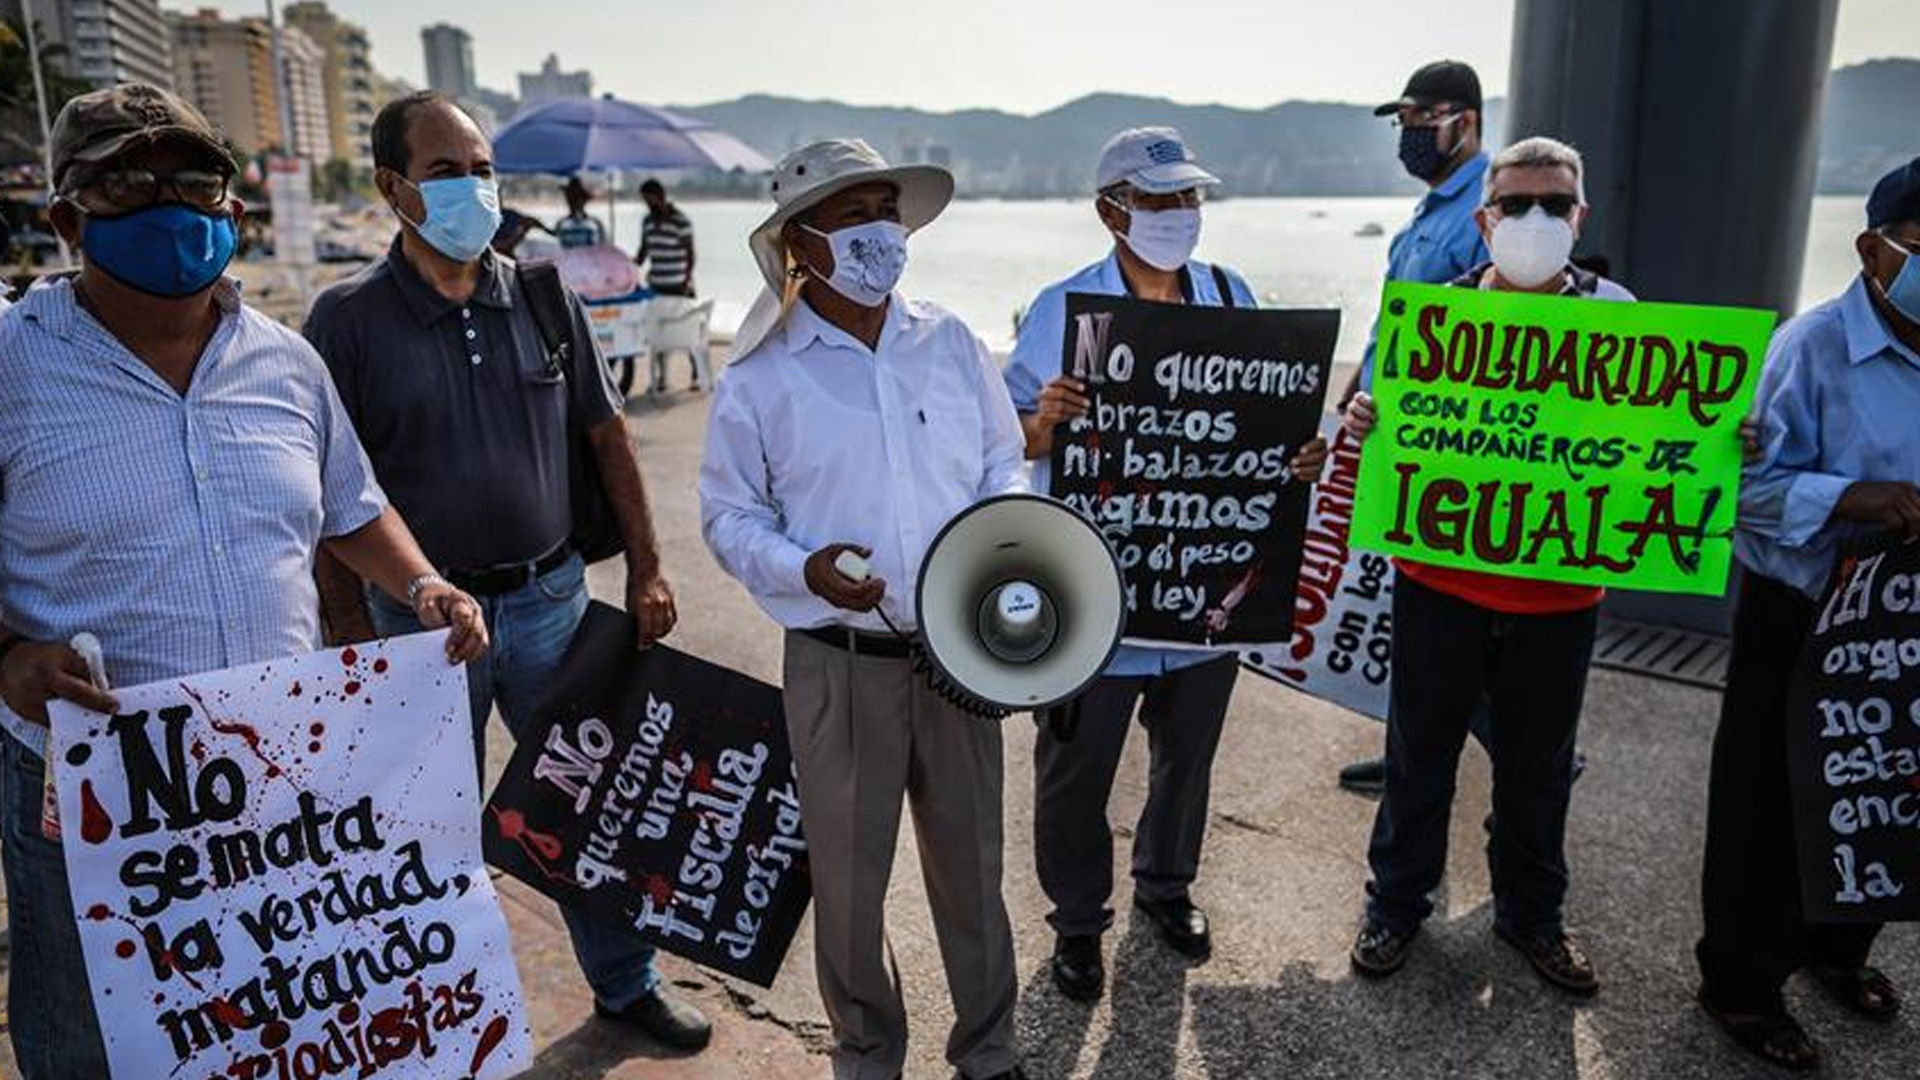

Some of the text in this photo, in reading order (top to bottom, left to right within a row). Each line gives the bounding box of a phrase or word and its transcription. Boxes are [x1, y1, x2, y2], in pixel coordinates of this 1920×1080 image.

[1073, 312, 1319, 400] No queremos
[1399, 390, 1539, 428] CON LOS
[1123, 437, 1291, 484] balazos,
[1645, 438, 1698, 475] DE
[1147, 532, 1175, 570] el
[1180, 540, 1253, 577] peso
[1152, 580, 1206, 620] ley
[1326, 552, 1389, 675] con los
[1817, 697, 1892, 738] no
[532, 717, 615, 814] No
[575, 692, 675, 889] queremos
[1833, 844, 1904, 904] la
[144, 839, 471, 981] la verdad,
[157, 922, 456, 1060] matando
